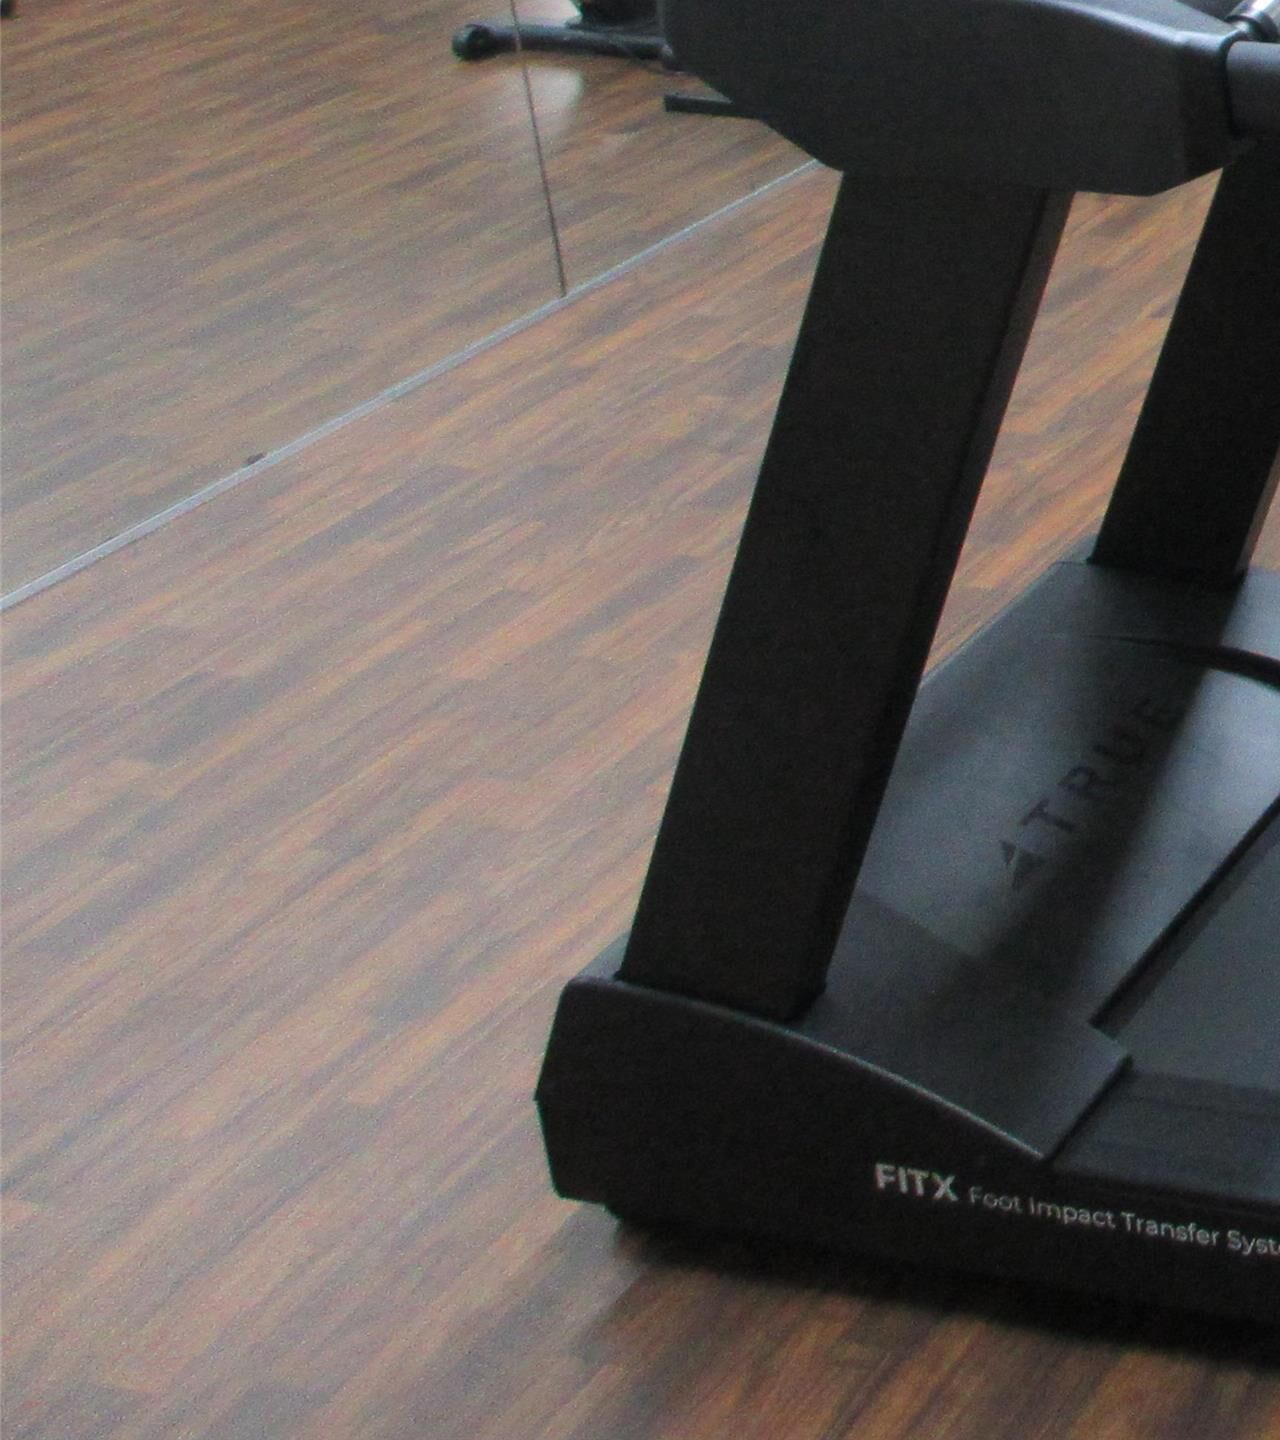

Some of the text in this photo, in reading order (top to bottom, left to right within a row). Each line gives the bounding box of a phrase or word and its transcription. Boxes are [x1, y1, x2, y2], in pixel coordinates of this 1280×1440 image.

[875, 1162, 959, 1202] FITX
[969, 1185, 1023, 1213] Foot
[1029, 1196, 1116, 1227] Impact
[1121, 1211, 1220, 1247] Transfer
